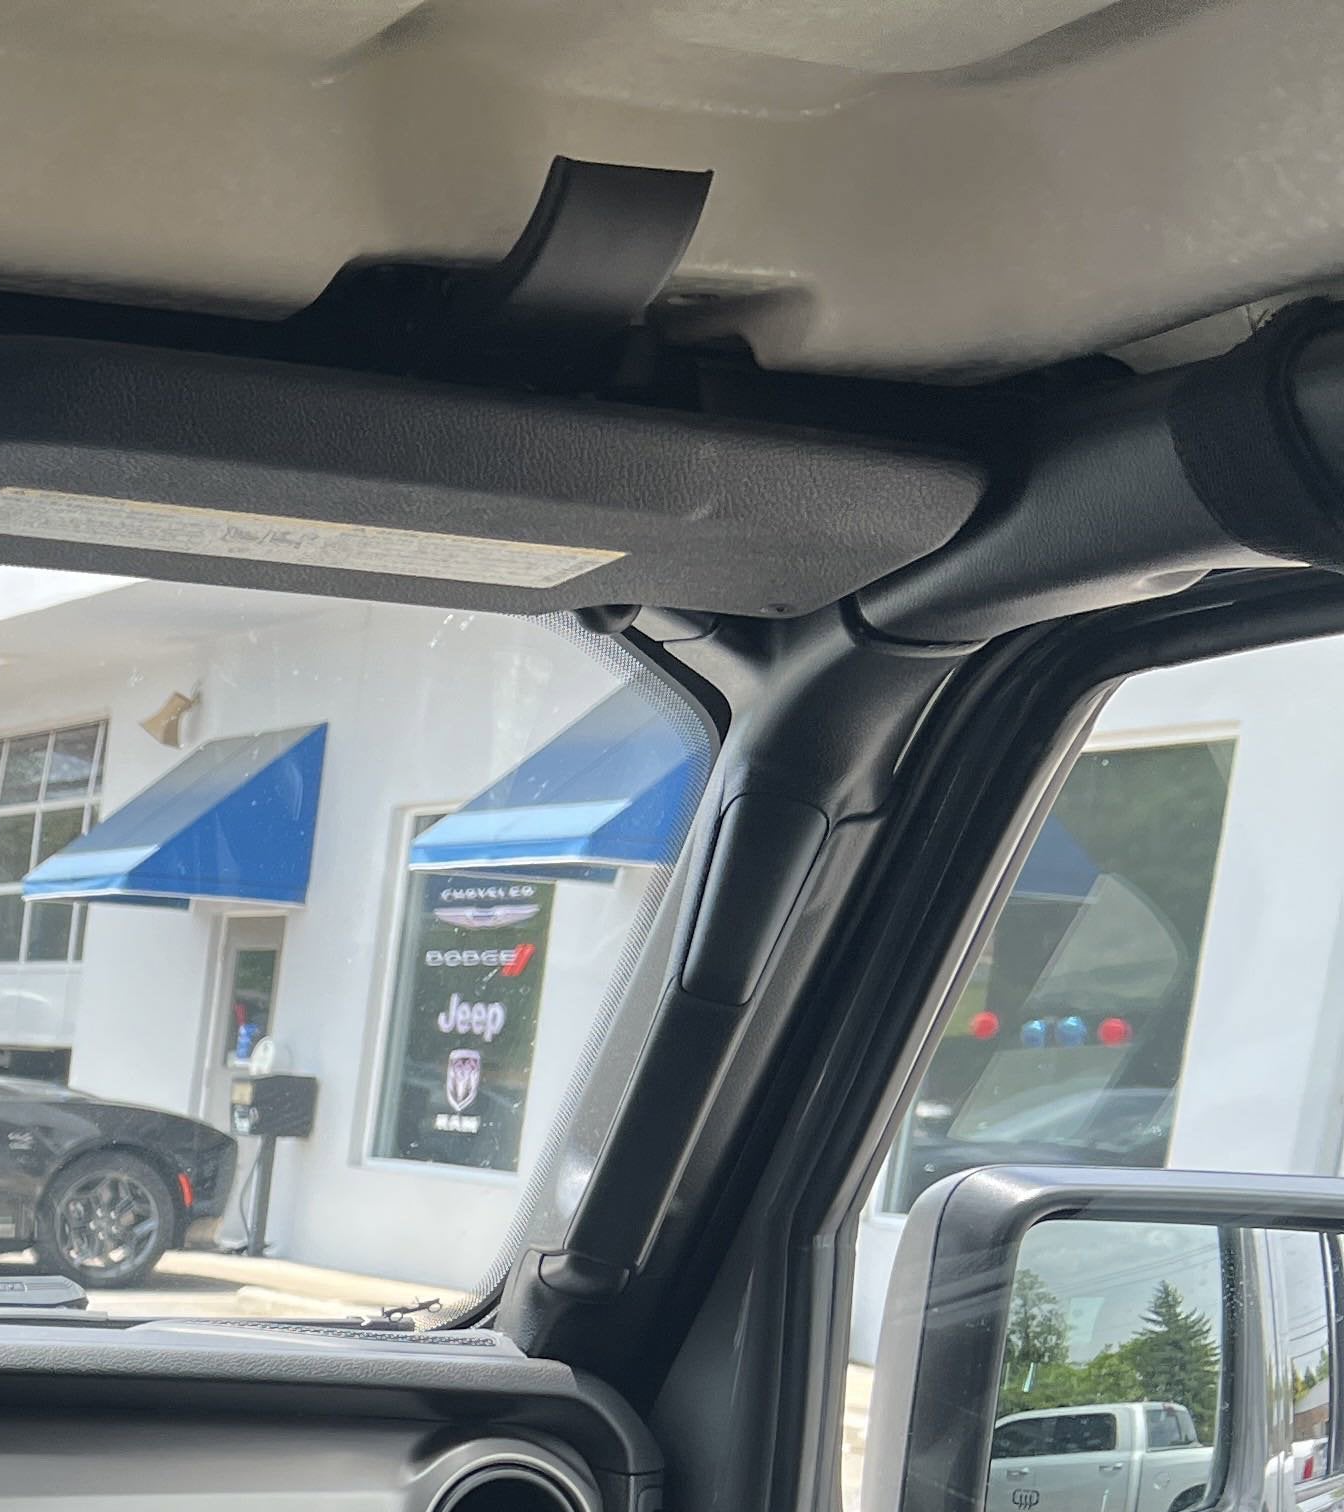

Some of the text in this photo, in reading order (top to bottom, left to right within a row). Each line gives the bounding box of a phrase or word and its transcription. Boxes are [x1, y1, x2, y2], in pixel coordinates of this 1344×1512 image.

[425, 950, 519, 966] DODGE
[438, 992, 506, 1043] Jeep
[434, 1113, 481, 1134] RAM
